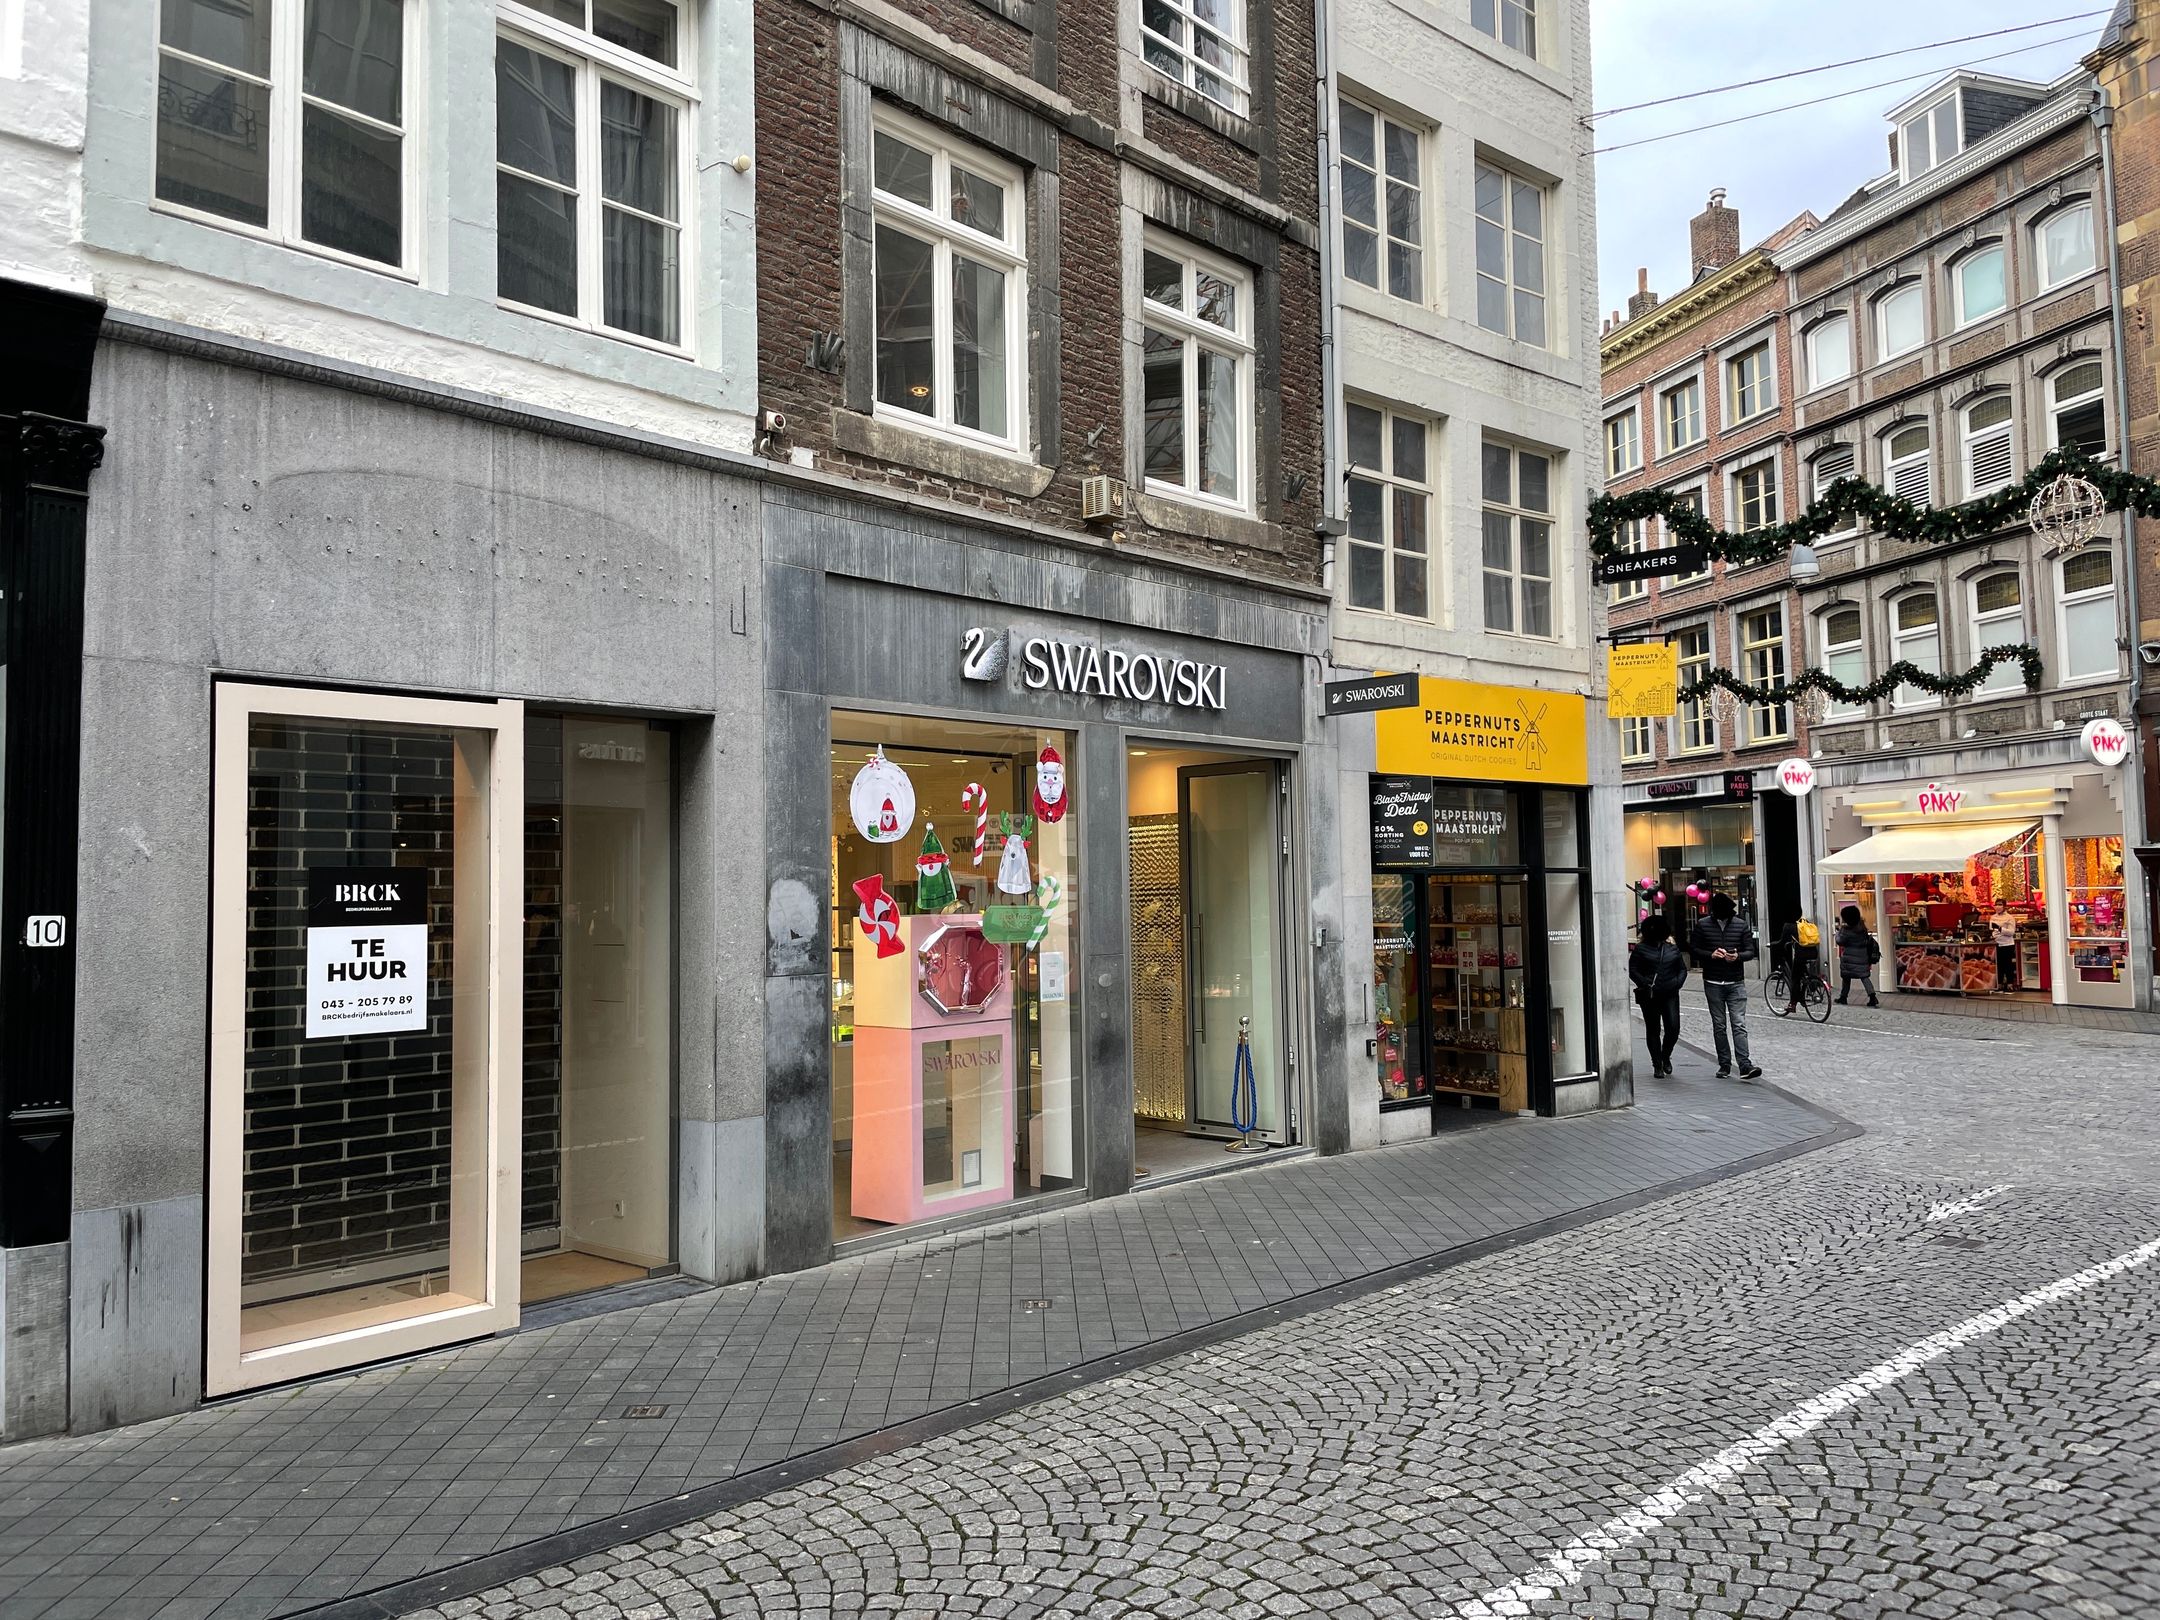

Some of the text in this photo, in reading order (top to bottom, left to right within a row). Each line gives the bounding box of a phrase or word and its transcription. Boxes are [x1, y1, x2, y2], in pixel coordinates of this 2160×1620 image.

[1607, 555, 1677, 574] SNEAKERS
[1613, 653, 1658, 661] PEPPERNUTS
[1023, 638, 1227, 709] SWAROVSKI
[1346, 684, 1404, 702] SWAROVSKI
[1425, 710, 1520, 732] PEPPERNUTS
[2080, 709, 2109, 719] GROTE STAAT
[1431, 731, 1515, 749] MAASTRICHT
[1430, 752, 1518, 765] ORIGINAL DUTCH COOKIES
[1384, 803, 1418, 818] Deal
[1434, 809, 1502, 822] PEPPERNUTS
[1435, 823, 1501, 835] MAASTRICHT
[335, 884, 401, 902] BRCK
[33, 919, 62, 943] 10
[351, 938, 385, 958] TE
[327, 960, 407, 982] HUUR
[321, 1000, 344, 1009] 043
[357, 998, 379, 1007] 205
[382, 996, 396, 1005] 79
[399, 995, 413, 1004] 89
[321, 1008, 413, 1020] BRCKbedrijfsmakelaars.nl
[924, 1049, 1001, 1073] SWAROVSKI
